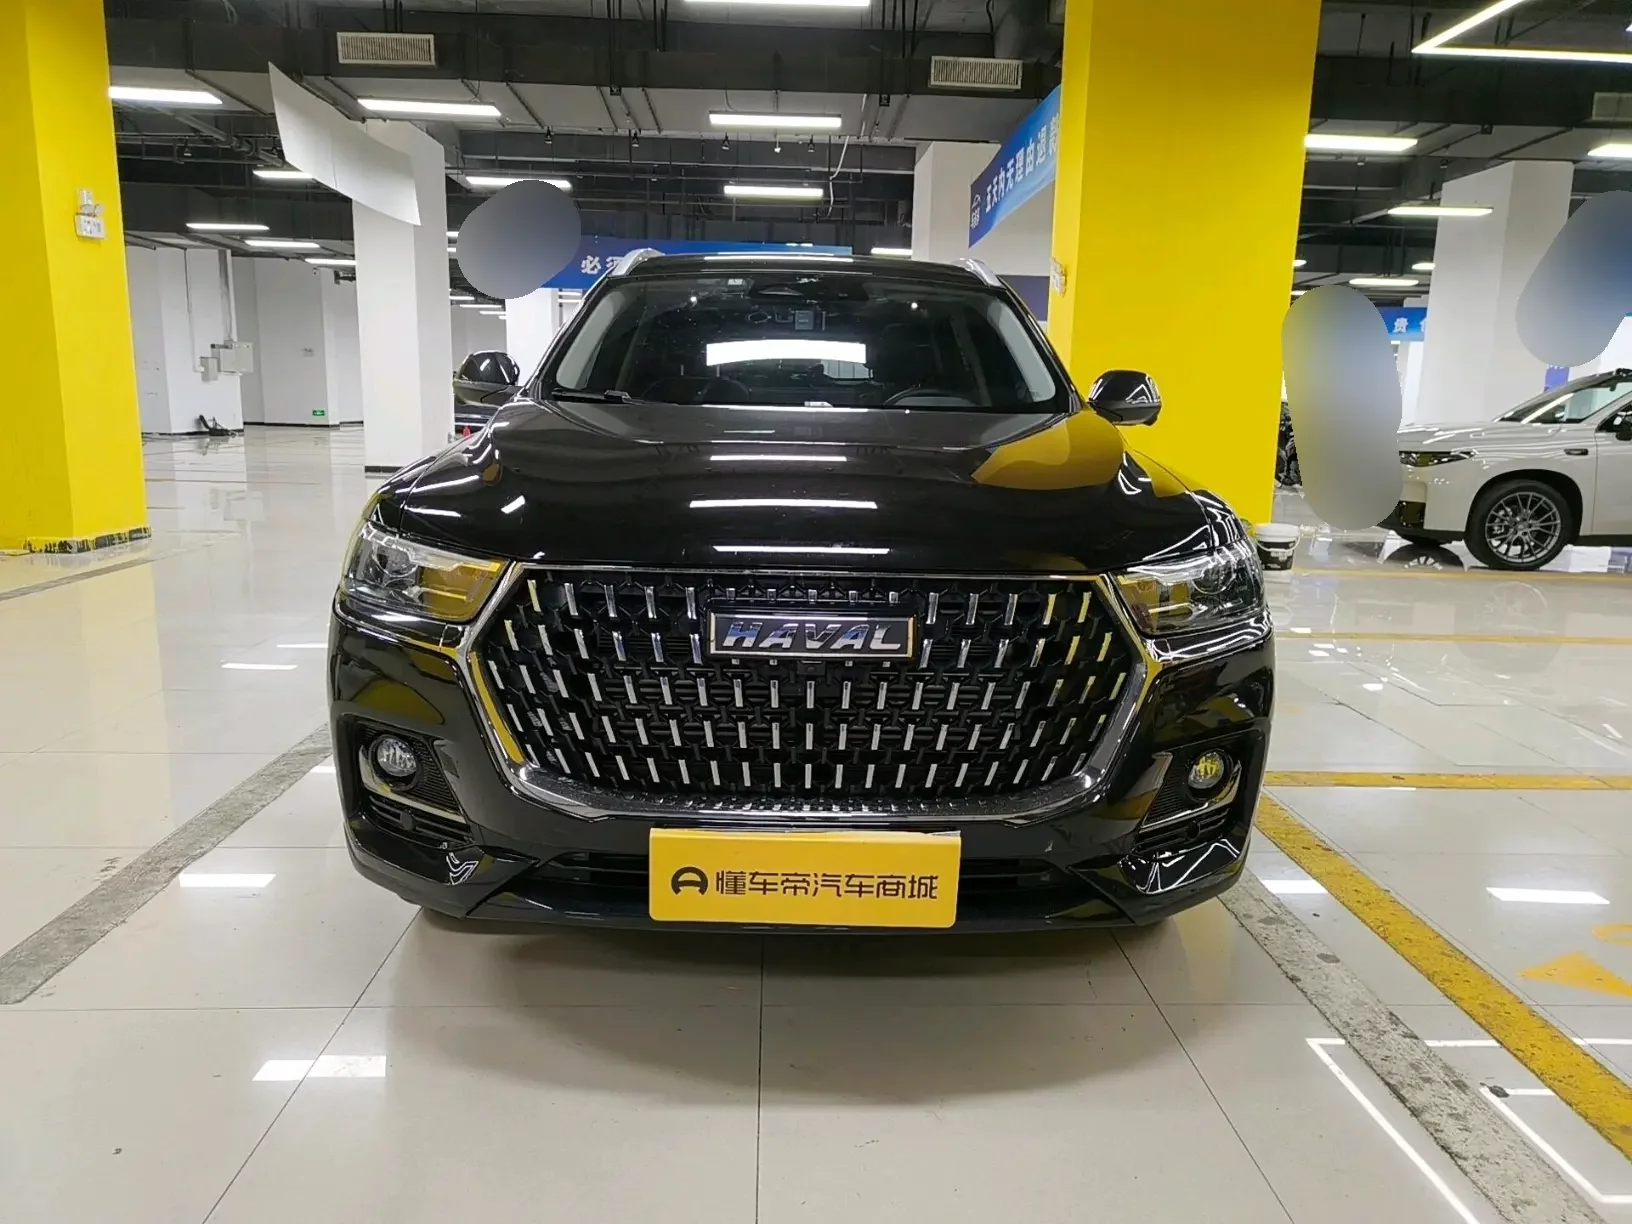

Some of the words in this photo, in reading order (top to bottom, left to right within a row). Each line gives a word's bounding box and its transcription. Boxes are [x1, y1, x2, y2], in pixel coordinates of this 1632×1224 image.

[722, 621, 901, 649] HAVAL
[715, 870, 939, 899] 懂车帝汽车商城
